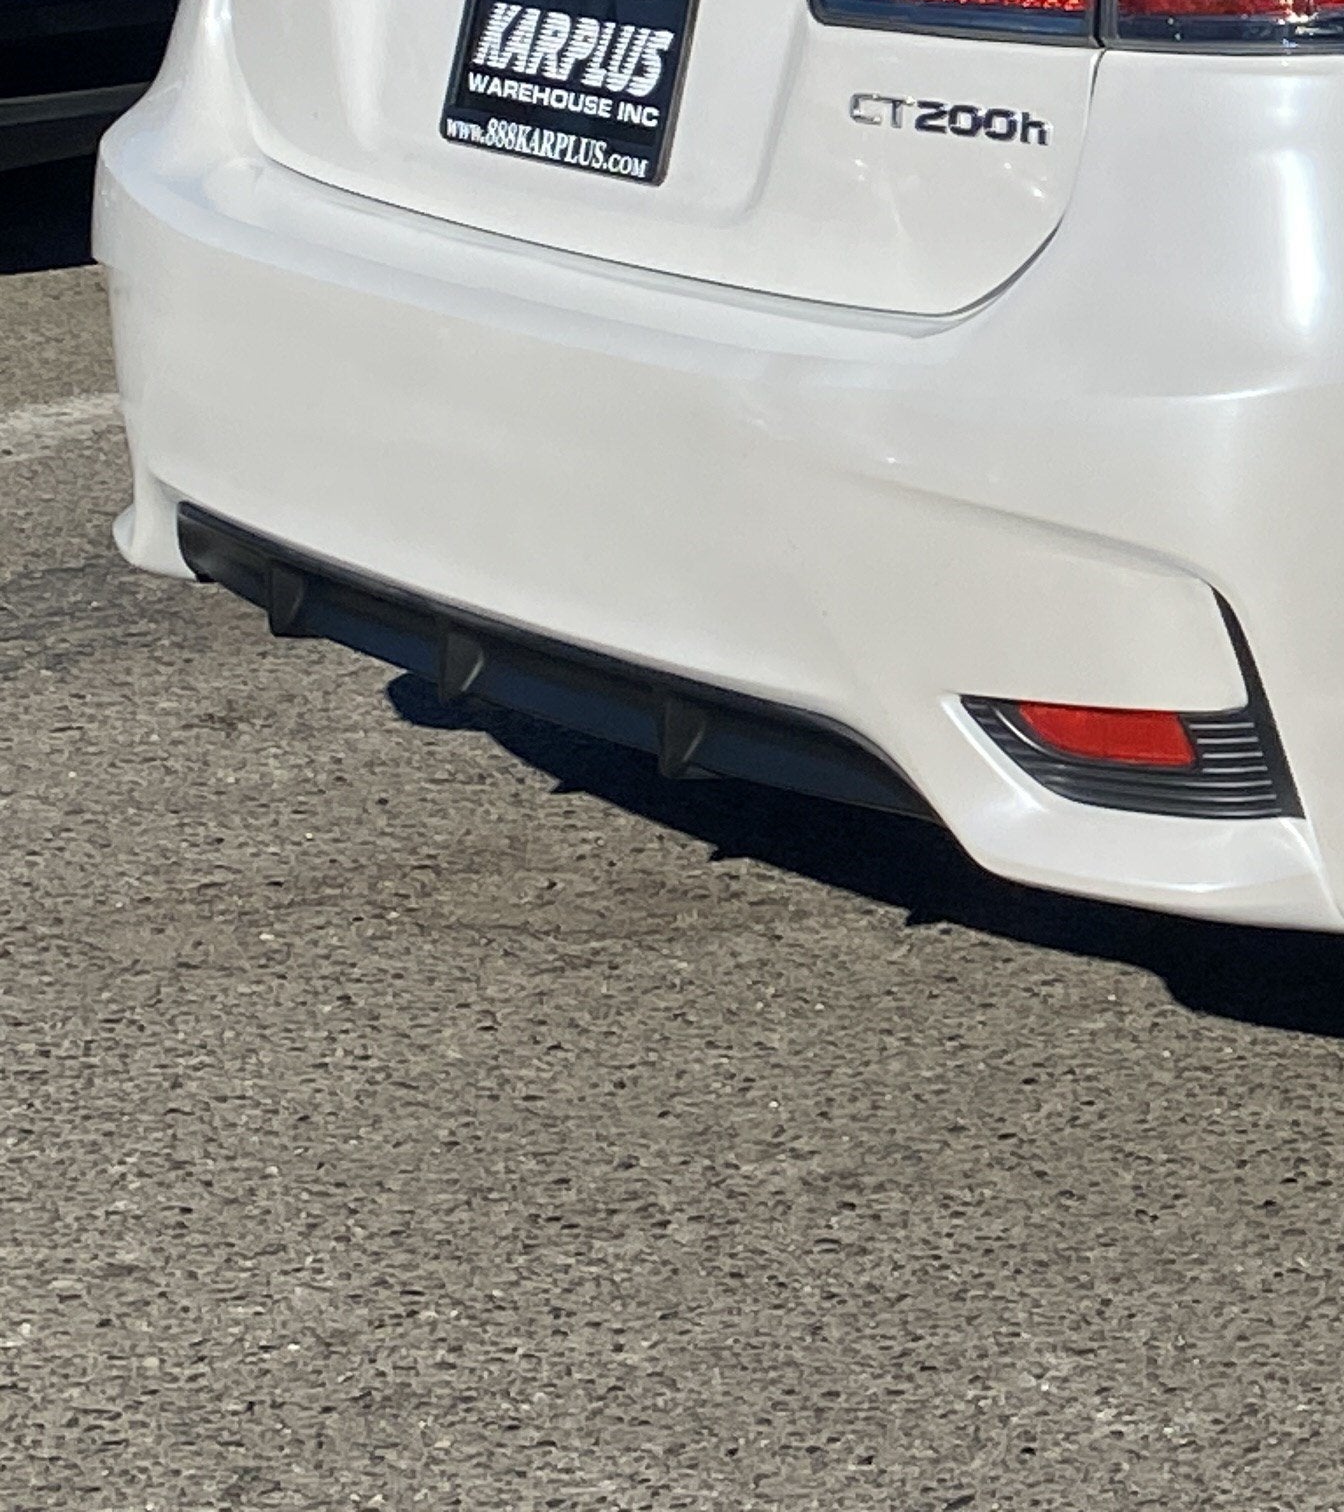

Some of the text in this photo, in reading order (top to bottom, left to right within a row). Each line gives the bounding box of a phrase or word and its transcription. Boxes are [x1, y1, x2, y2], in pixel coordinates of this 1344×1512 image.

[472, 2, 674, 97] KARPLUS
[468, 71, 660, 128] WAREHOUSE INC
